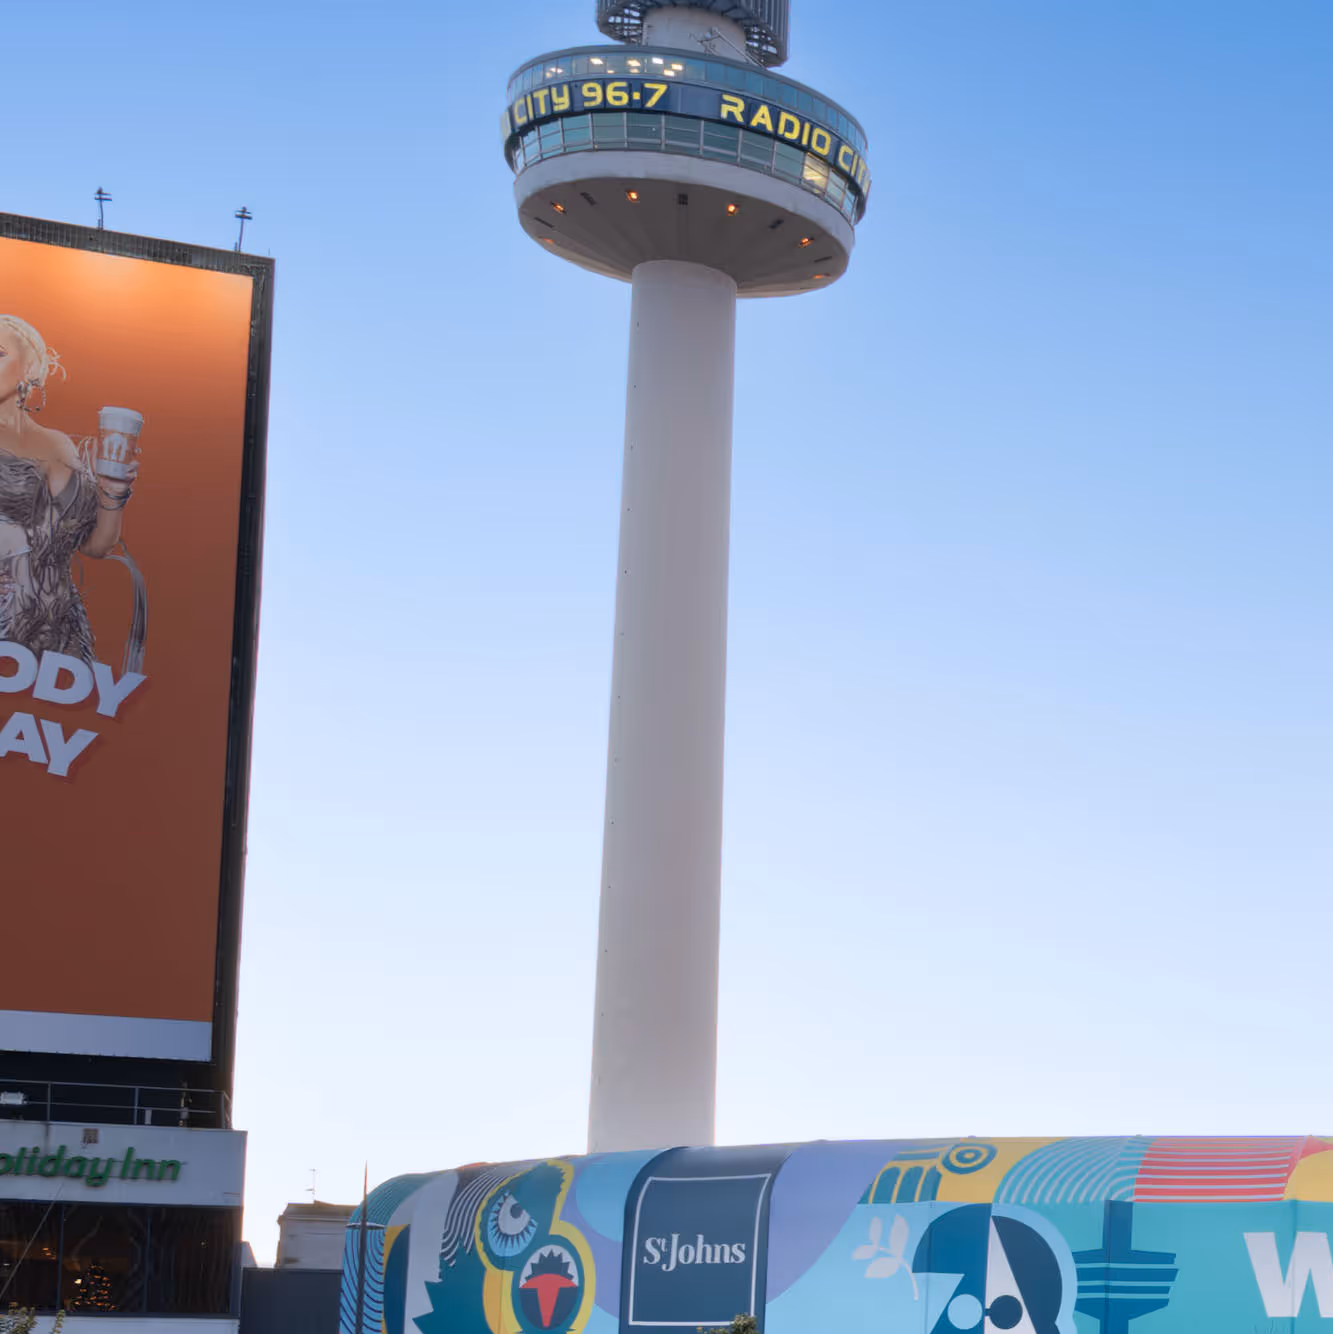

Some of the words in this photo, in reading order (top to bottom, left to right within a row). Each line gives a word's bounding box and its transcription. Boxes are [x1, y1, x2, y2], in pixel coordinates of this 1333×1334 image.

[513, 84, 571, 125] CITY
[720, 93, 832, 156] RADIO
[120, 1146, 181, 1181] Inn
